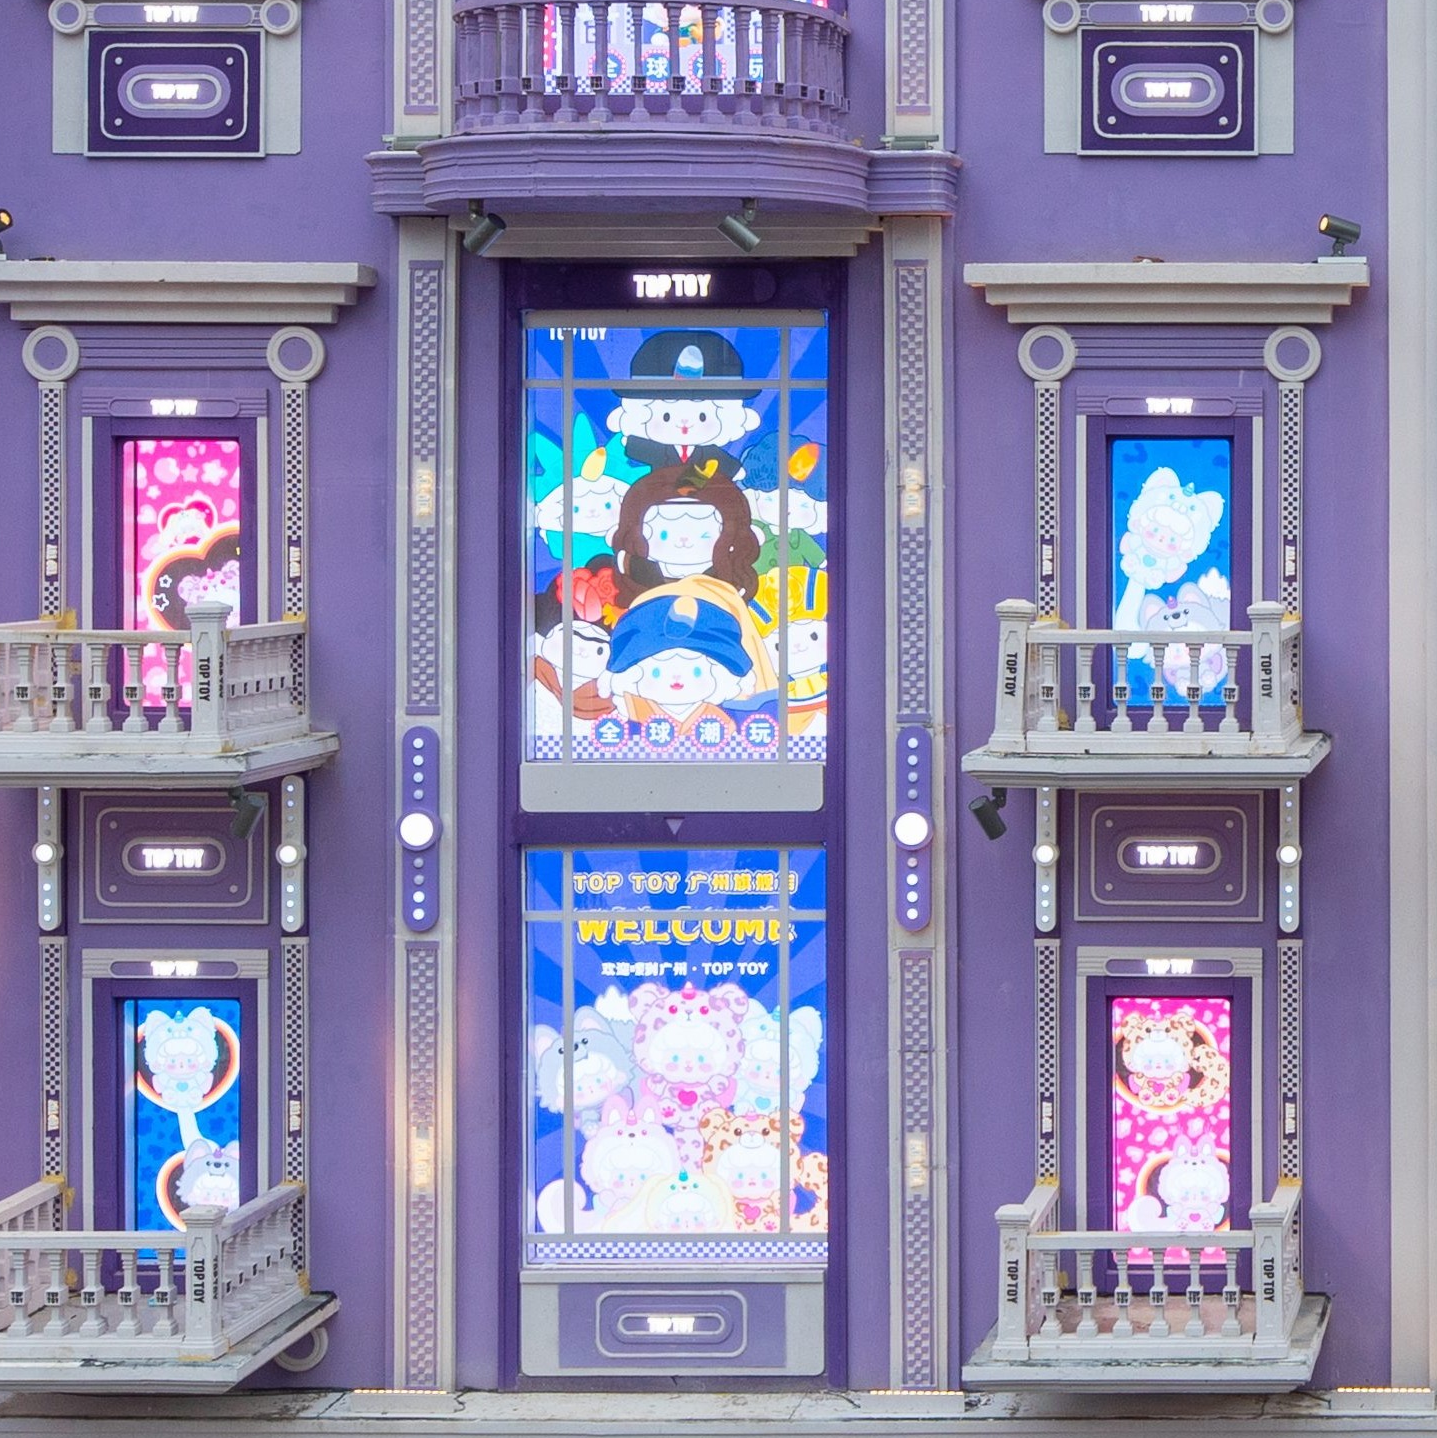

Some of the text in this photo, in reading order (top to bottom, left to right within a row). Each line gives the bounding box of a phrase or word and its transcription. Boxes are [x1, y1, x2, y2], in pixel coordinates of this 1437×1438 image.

[633, 274, 711, 299] TOP TOY
[199, 656, 211, 701] TOP TOY
[1005, 652, 1018, 698] TOP TOY
[598, 720, 771, 745] 全球潮玩
[142, 848, 204, 869] TOP TOY
[1138, 846, 1198, 866] TOP TOY
[574, 872, 622, 894] TOP
[630, 872, 679, 894] TOY
[702, 961, 732, 975] TOP
[738, 961, 768, 975] TOY
[194, 1259, 205, 1304] TOP TOY
